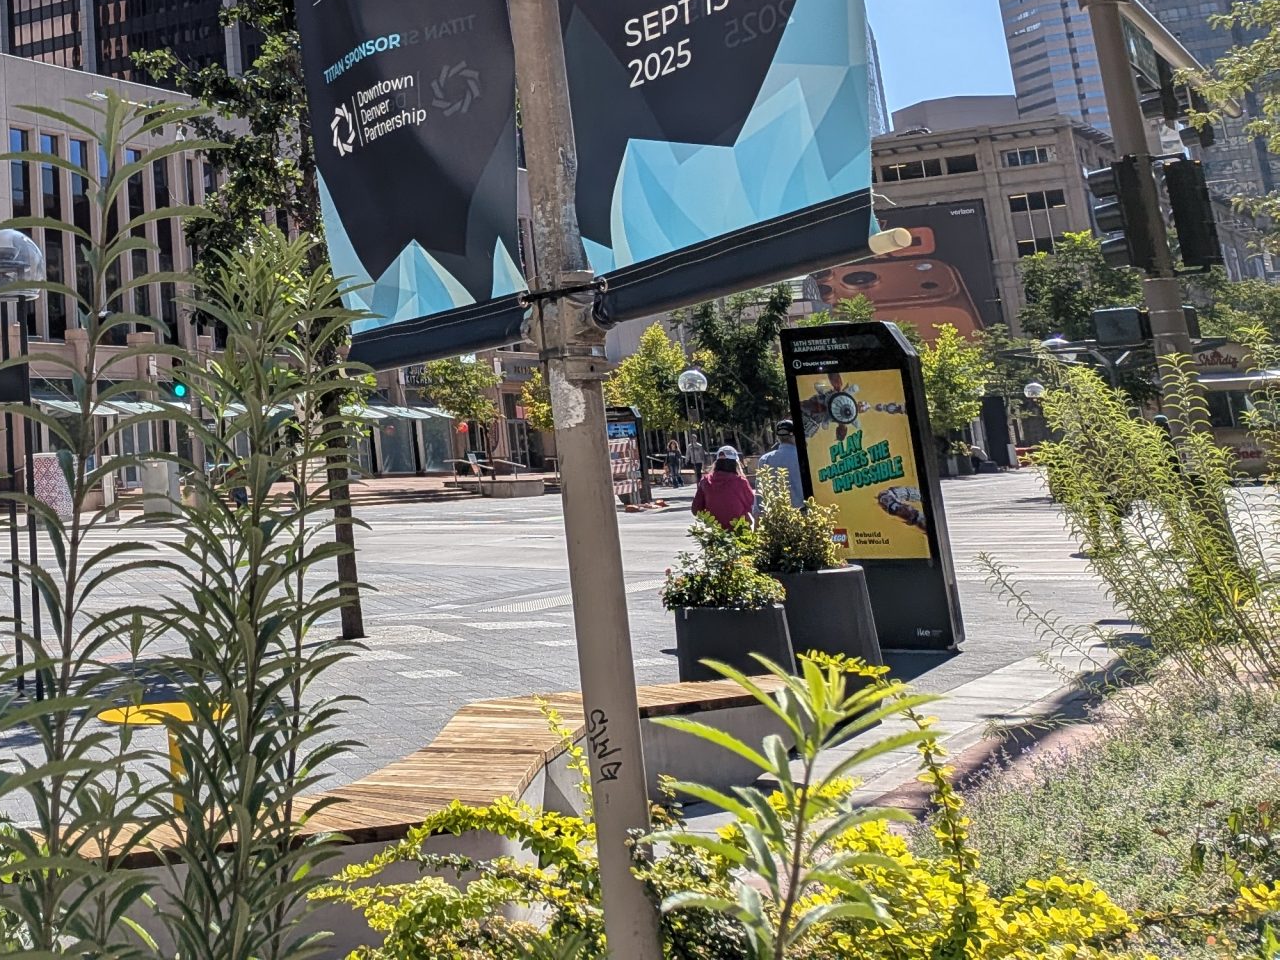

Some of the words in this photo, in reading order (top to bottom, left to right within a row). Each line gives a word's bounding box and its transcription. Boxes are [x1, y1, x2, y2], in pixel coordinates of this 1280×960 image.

[324, 59, 345, 84] TITAN
[344, 33, 401, 70] SPONSOR
[627, 38, 692, 88] 2025
[357, 74, 414, 107] Downtown
[360, 99, 390, 125] Denver
[364, 107, 427, 144] Partnership
[950, 208, 975, 216] verizon
[793, 344, 826, 353] ARAPAHOE
[827, 343, 850, 351] STREET
[808, 338, 830, 346] STREET
[818, 450, 869, 482] IMAGINES
[867, 440, 891, 463] THE
[829, 429, 863, 463] PLAY
[832, 456, 905, 494] IMPOSSIBLE
